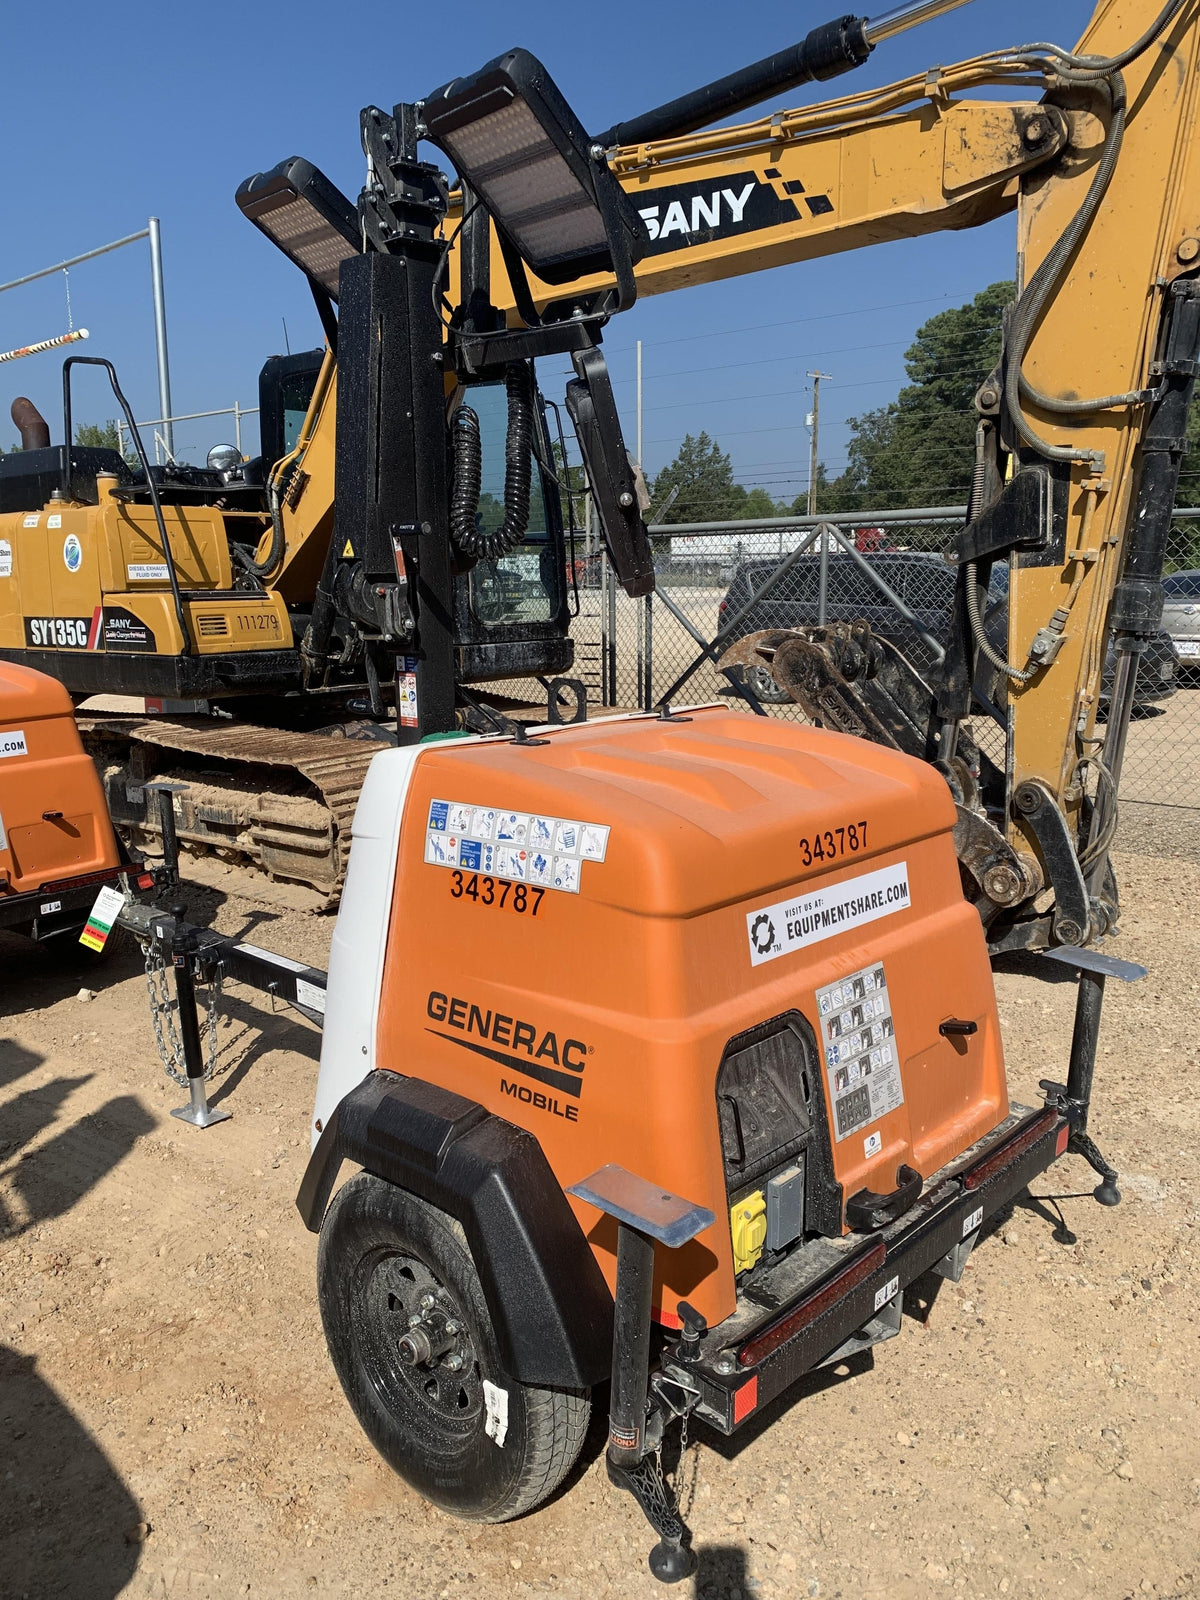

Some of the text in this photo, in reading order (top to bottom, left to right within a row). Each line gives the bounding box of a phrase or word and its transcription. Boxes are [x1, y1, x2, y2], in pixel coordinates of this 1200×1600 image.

[638, 182, 756, 241] SANY
[30, 619, 87, 646] SY135C
[109, 619, 131, 628] SANY
[237, 614, 278, 630] 111279
[0, 741, 25, 753] .COM
[800, 821, 868, 866] 343787
[450, 870, 546, 916] 343787
[784, 898, 825, 918] VISIT US AT:
[786, 882, 908, 940] EQUIPMENTSHARE.COM
[427, 990, 587, 1073] GENERAC
[500, 1078, 579, 1122] MOBILE
